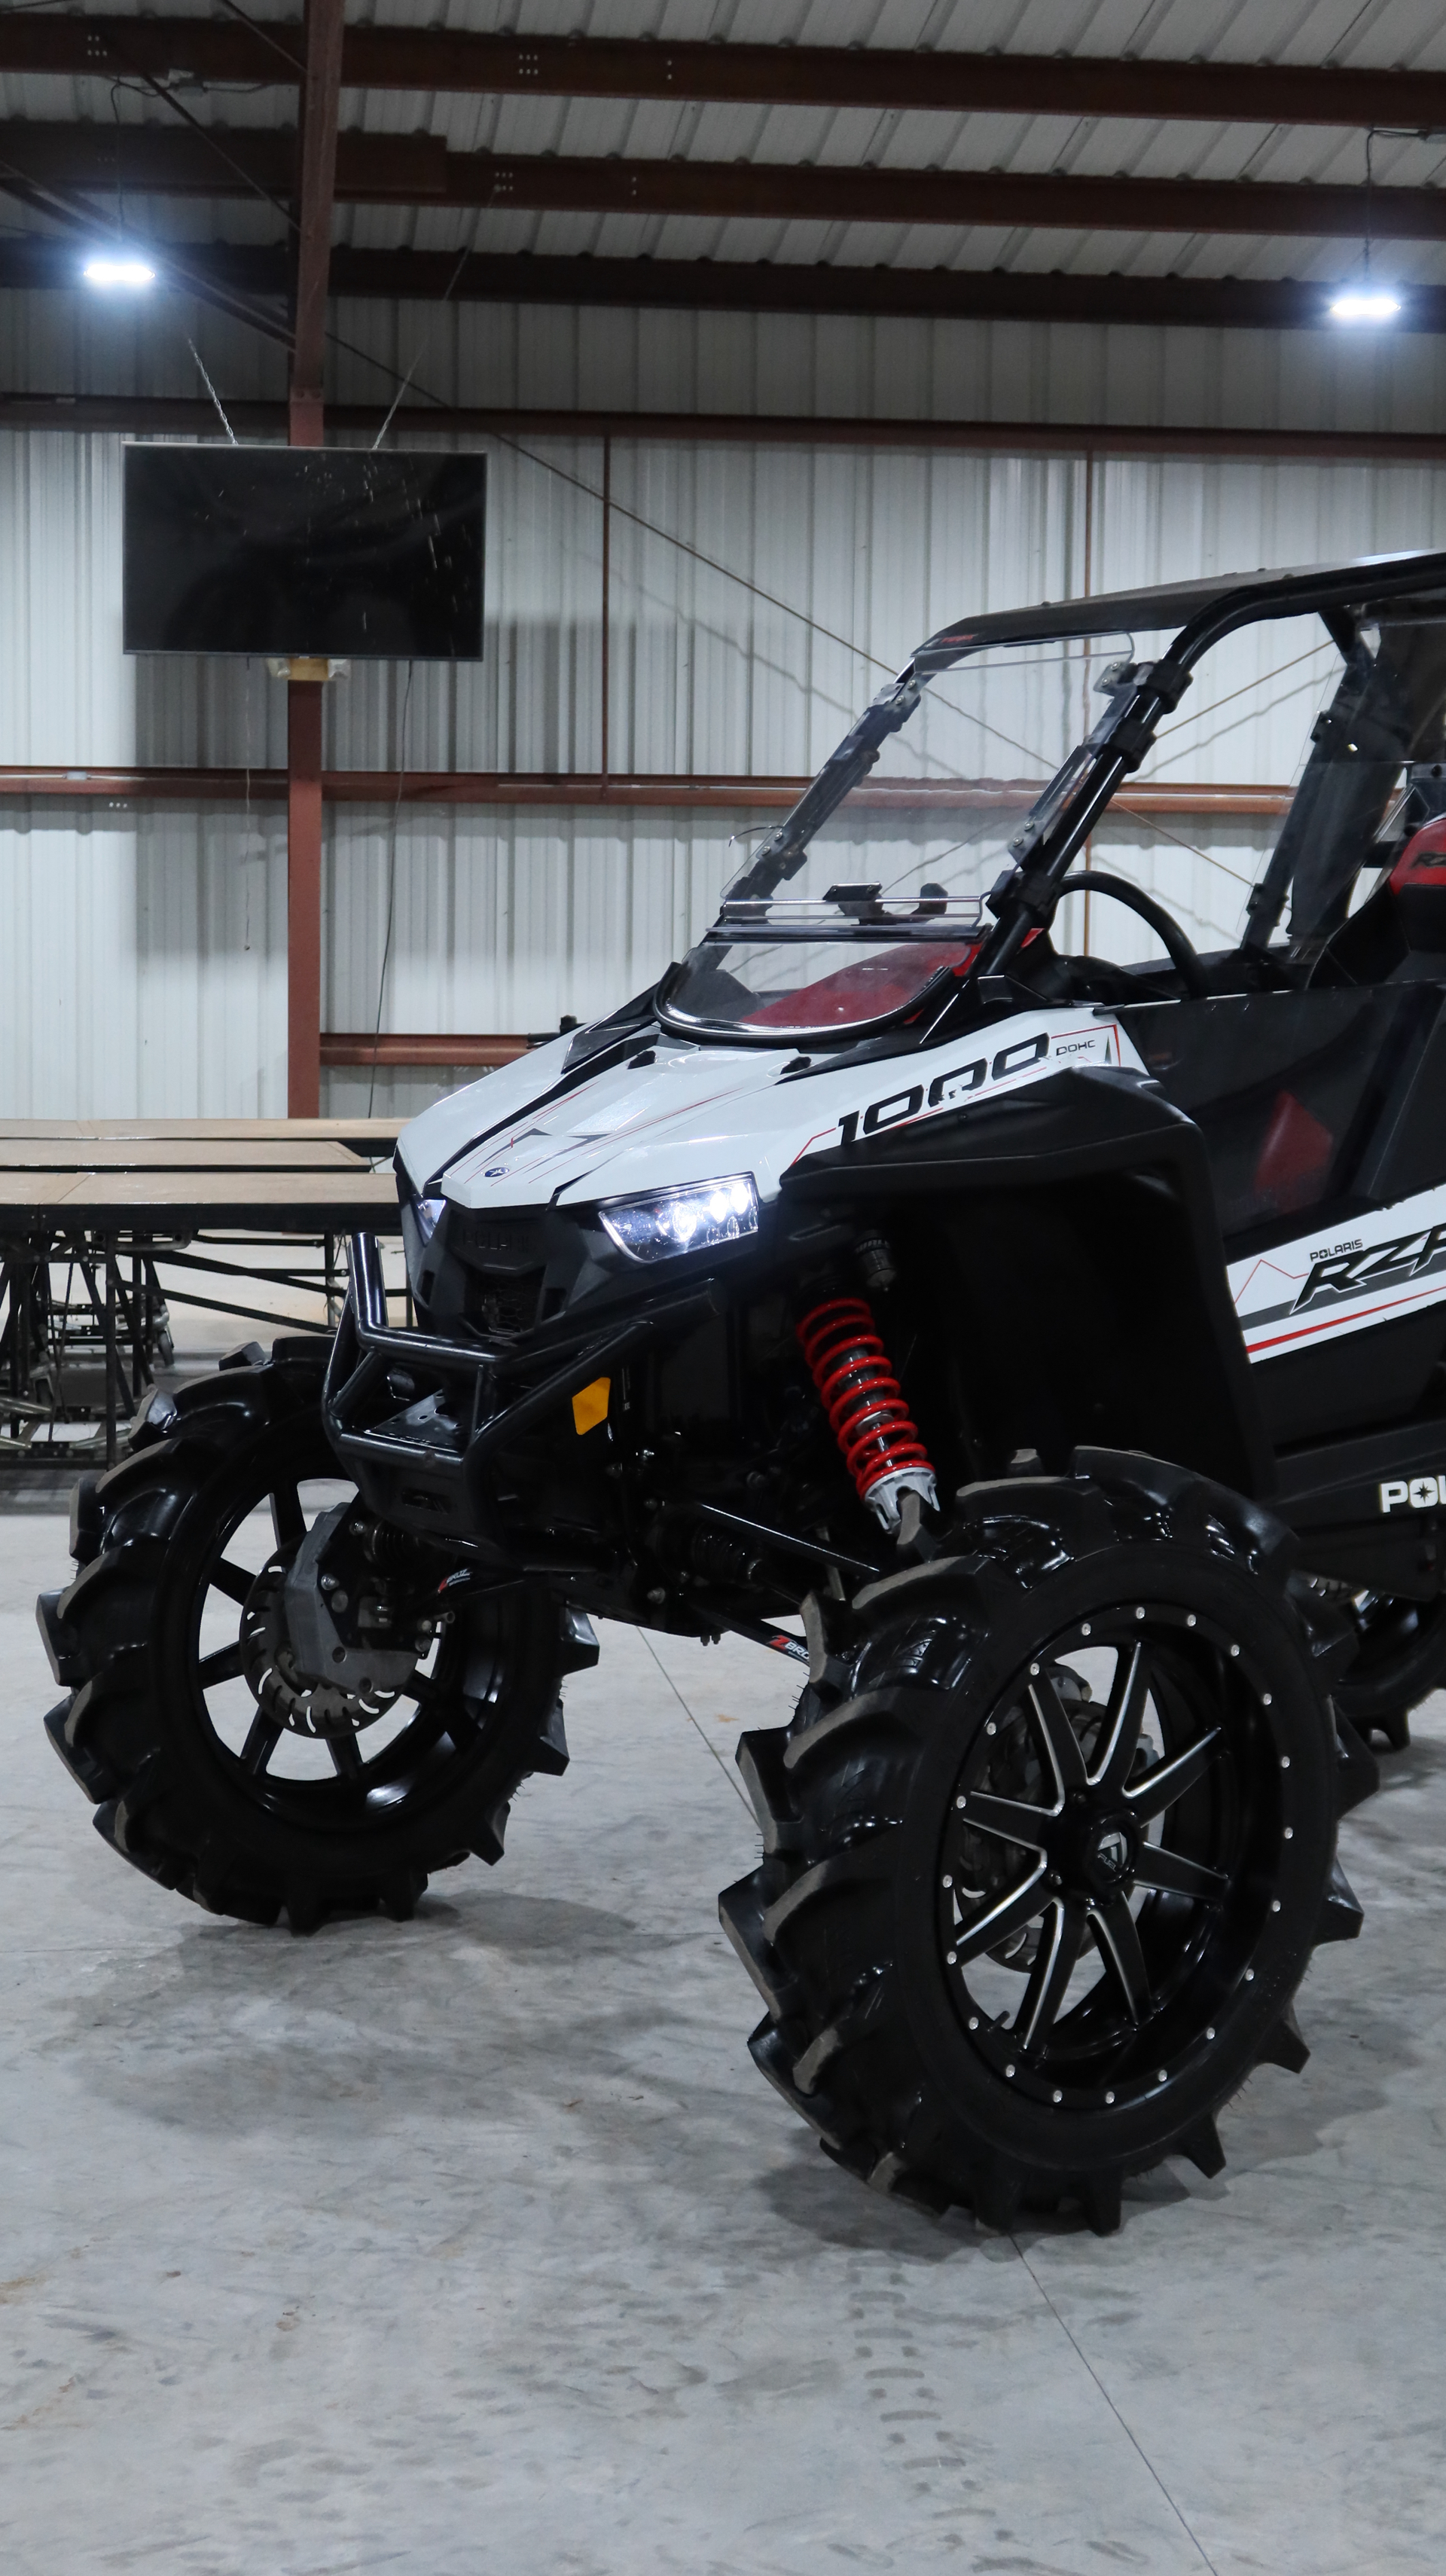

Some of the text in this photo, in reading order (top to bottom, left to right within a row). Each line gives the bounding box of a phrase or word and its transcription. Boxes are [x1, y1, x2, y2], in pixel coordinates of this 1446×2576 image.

[837, 1032, 1097, 1145] 1000 DOHC
[1309, 1238, 1364, 1262] POLARIS
[1097, 1853, 1116, 1872] FUEL
